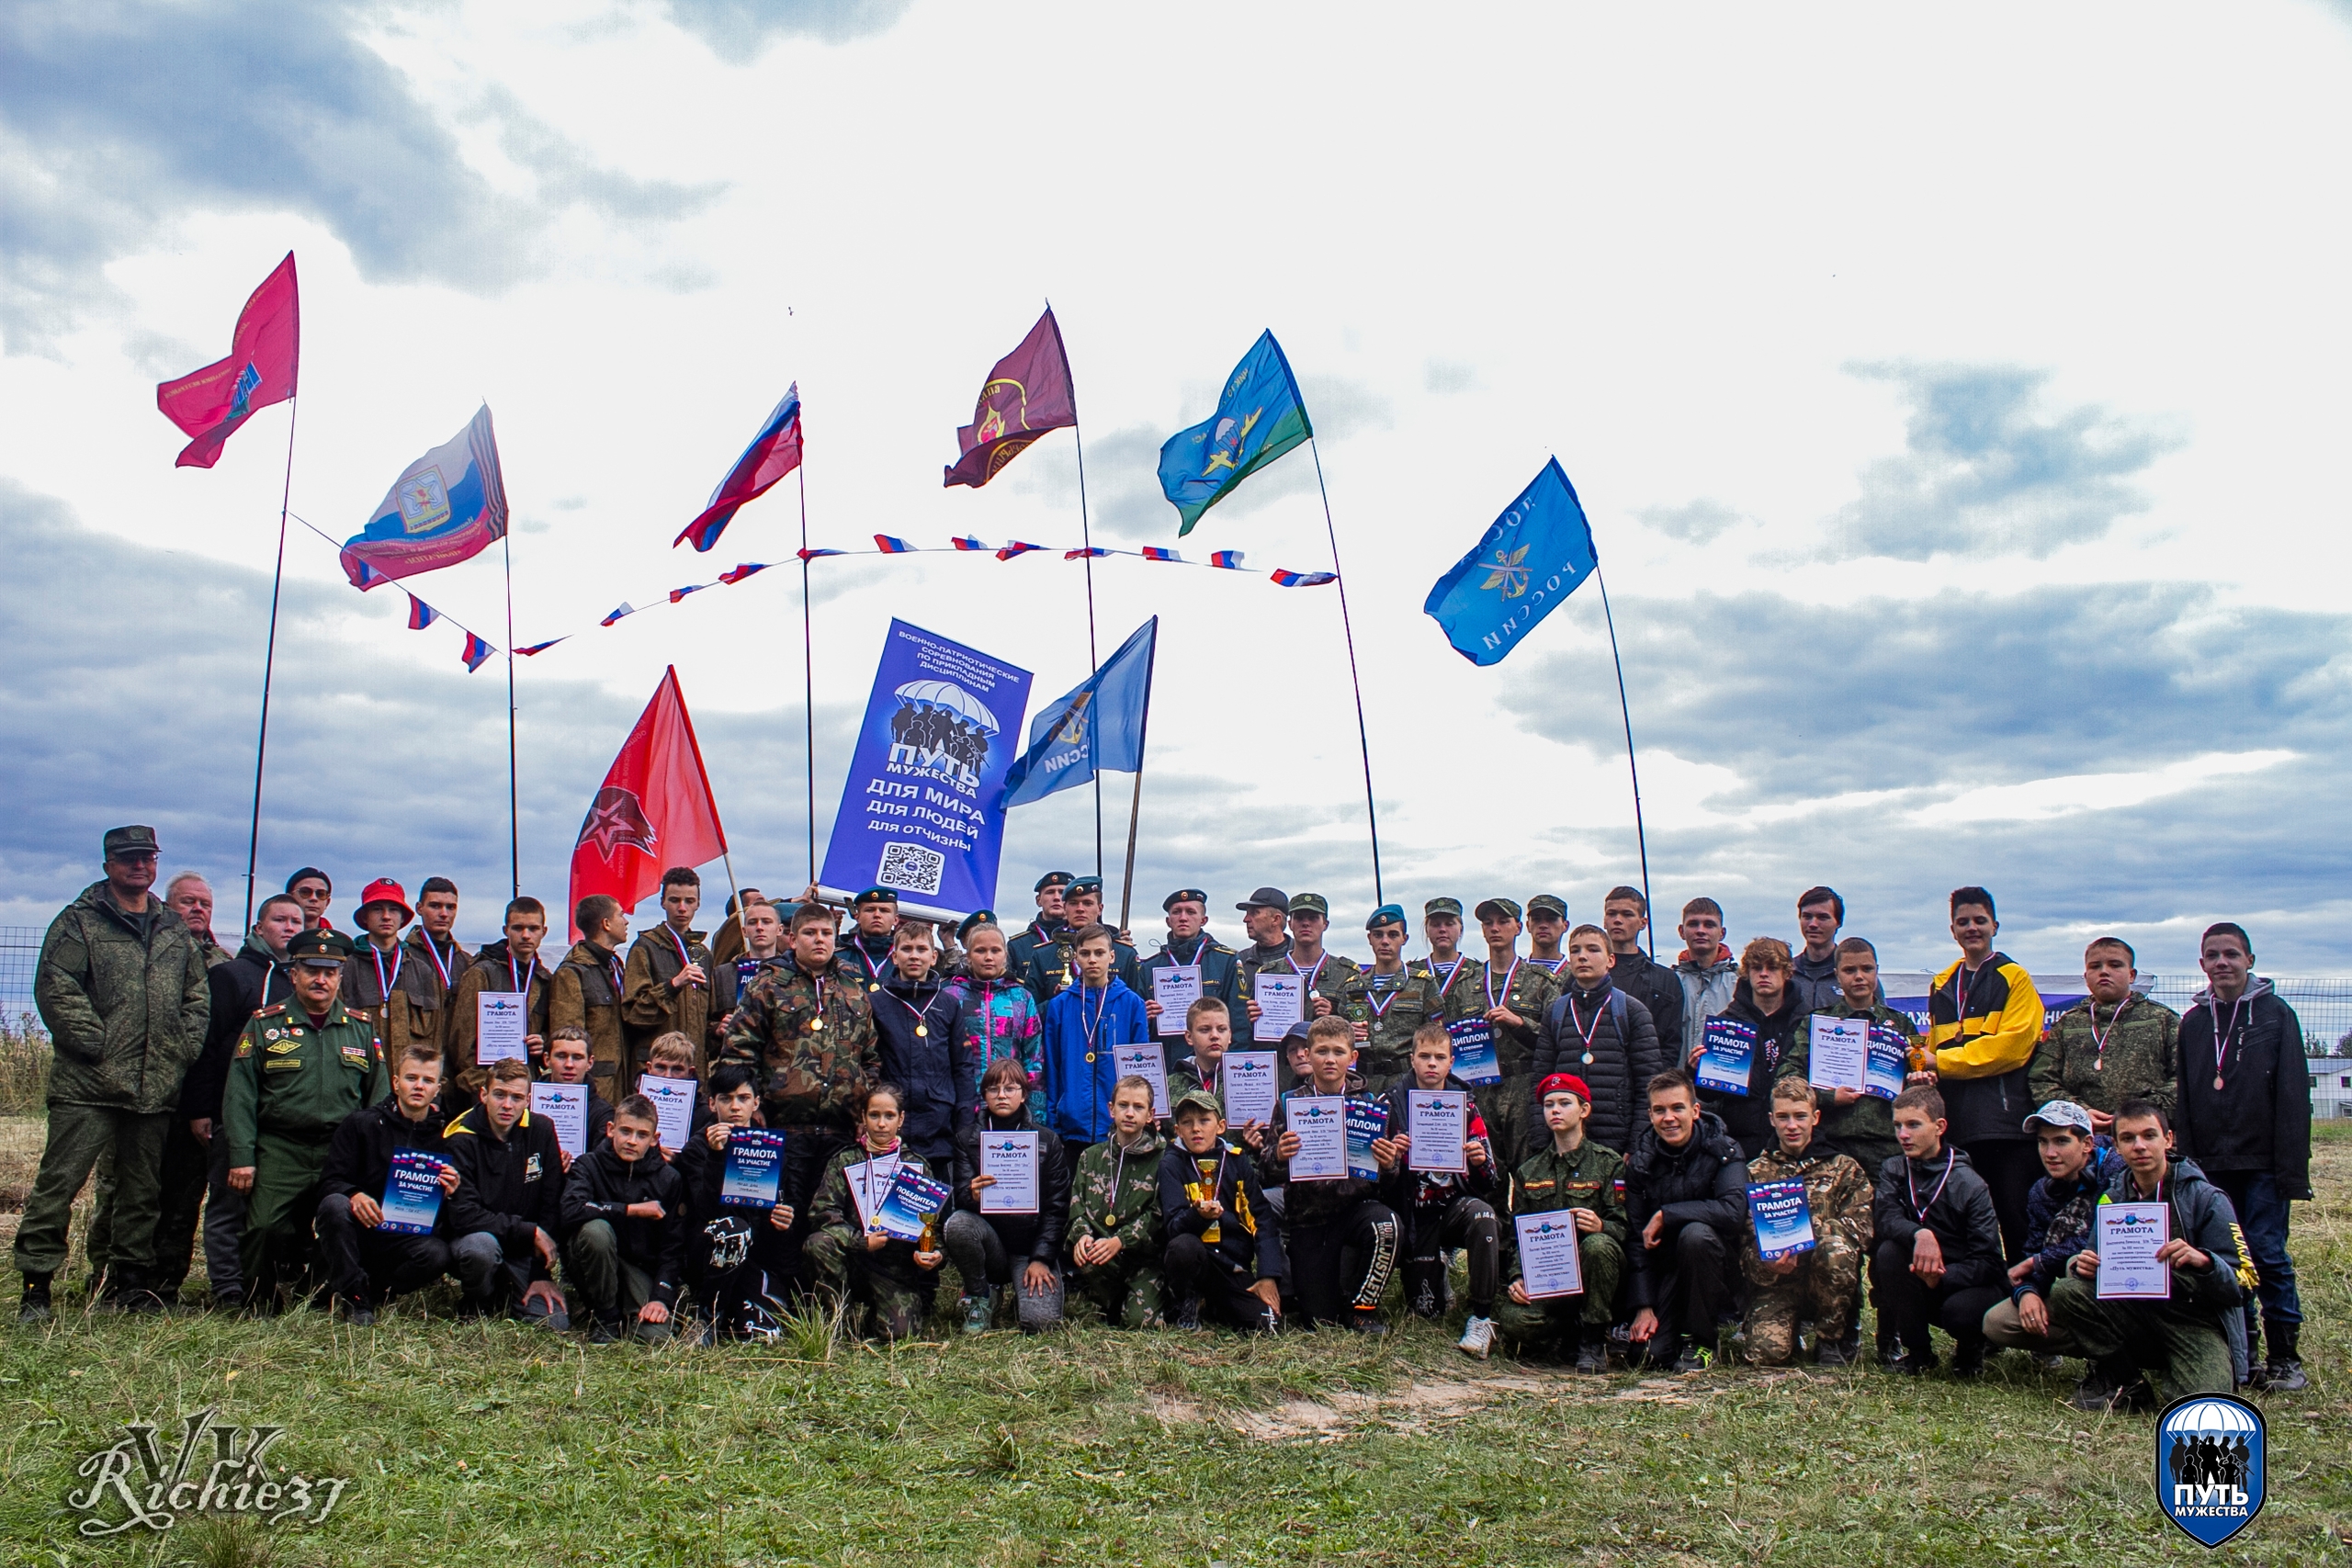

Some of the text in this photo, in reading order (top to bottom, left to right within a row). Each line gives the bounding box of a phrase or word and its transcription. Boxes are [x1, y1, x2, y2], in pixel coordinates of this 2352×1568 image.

[899, 630, 1020, 683] ВОЕННО-ПАТРИОТИЧЕСКИЕ
[922, 646, 995, 680] СОРЕВНОВАНИЯ
[916, 652, 996, 688] ПО ПРИКЛАДНЫМ
[920, 660, 989, 693] ДИСЦИПЛИНАМ
[888, 742, 980, 788] ПУТЬ
[886, 762, 977, 799] МУЖЕСТВА
[866, 778, 986, 826] ДЛЯ МИРА
[866, 799, 978, 840] ДЛЯ ЛЮДЕЙ
[867, 819, 971, 852] ДЛЯ ОТЧИЗНЫ
[1452, 1032, 1489, 1046] ДИПЛОМ
[1709, 1034, 1750, 1050] ГРАМОТА
[1821, 1035, 1856, 1043] ГРАМОТА
[1720, 1046, 1744, 1056] УЧАСТИЕ
[1867, 1040, 1905, 1058] ДИПЛОМ
[650, 1095, 683, 1103] ГРАМОТА
[1298, 1117, 1334, 1125] ГРАМОТА
[1346, 1118, 1381, 1132] ИПЛОМ
[733, 1146, 777, 1159] ГРАМОТА
[394, 1168, 441, 1185] ГРАМОТА
[407, 1183, 434, 1192] УЧАСТИЕ
[896, 1185, 938, 1208] ПОБЕДИТЕЛЬ
[1757, 1197, 1803, 1212] ГРАМОТА
[1772, 1208, 1798, 1218] УЧАСТИЕ
[1530, 1232, 1566, 1242] ГРАМОТА
